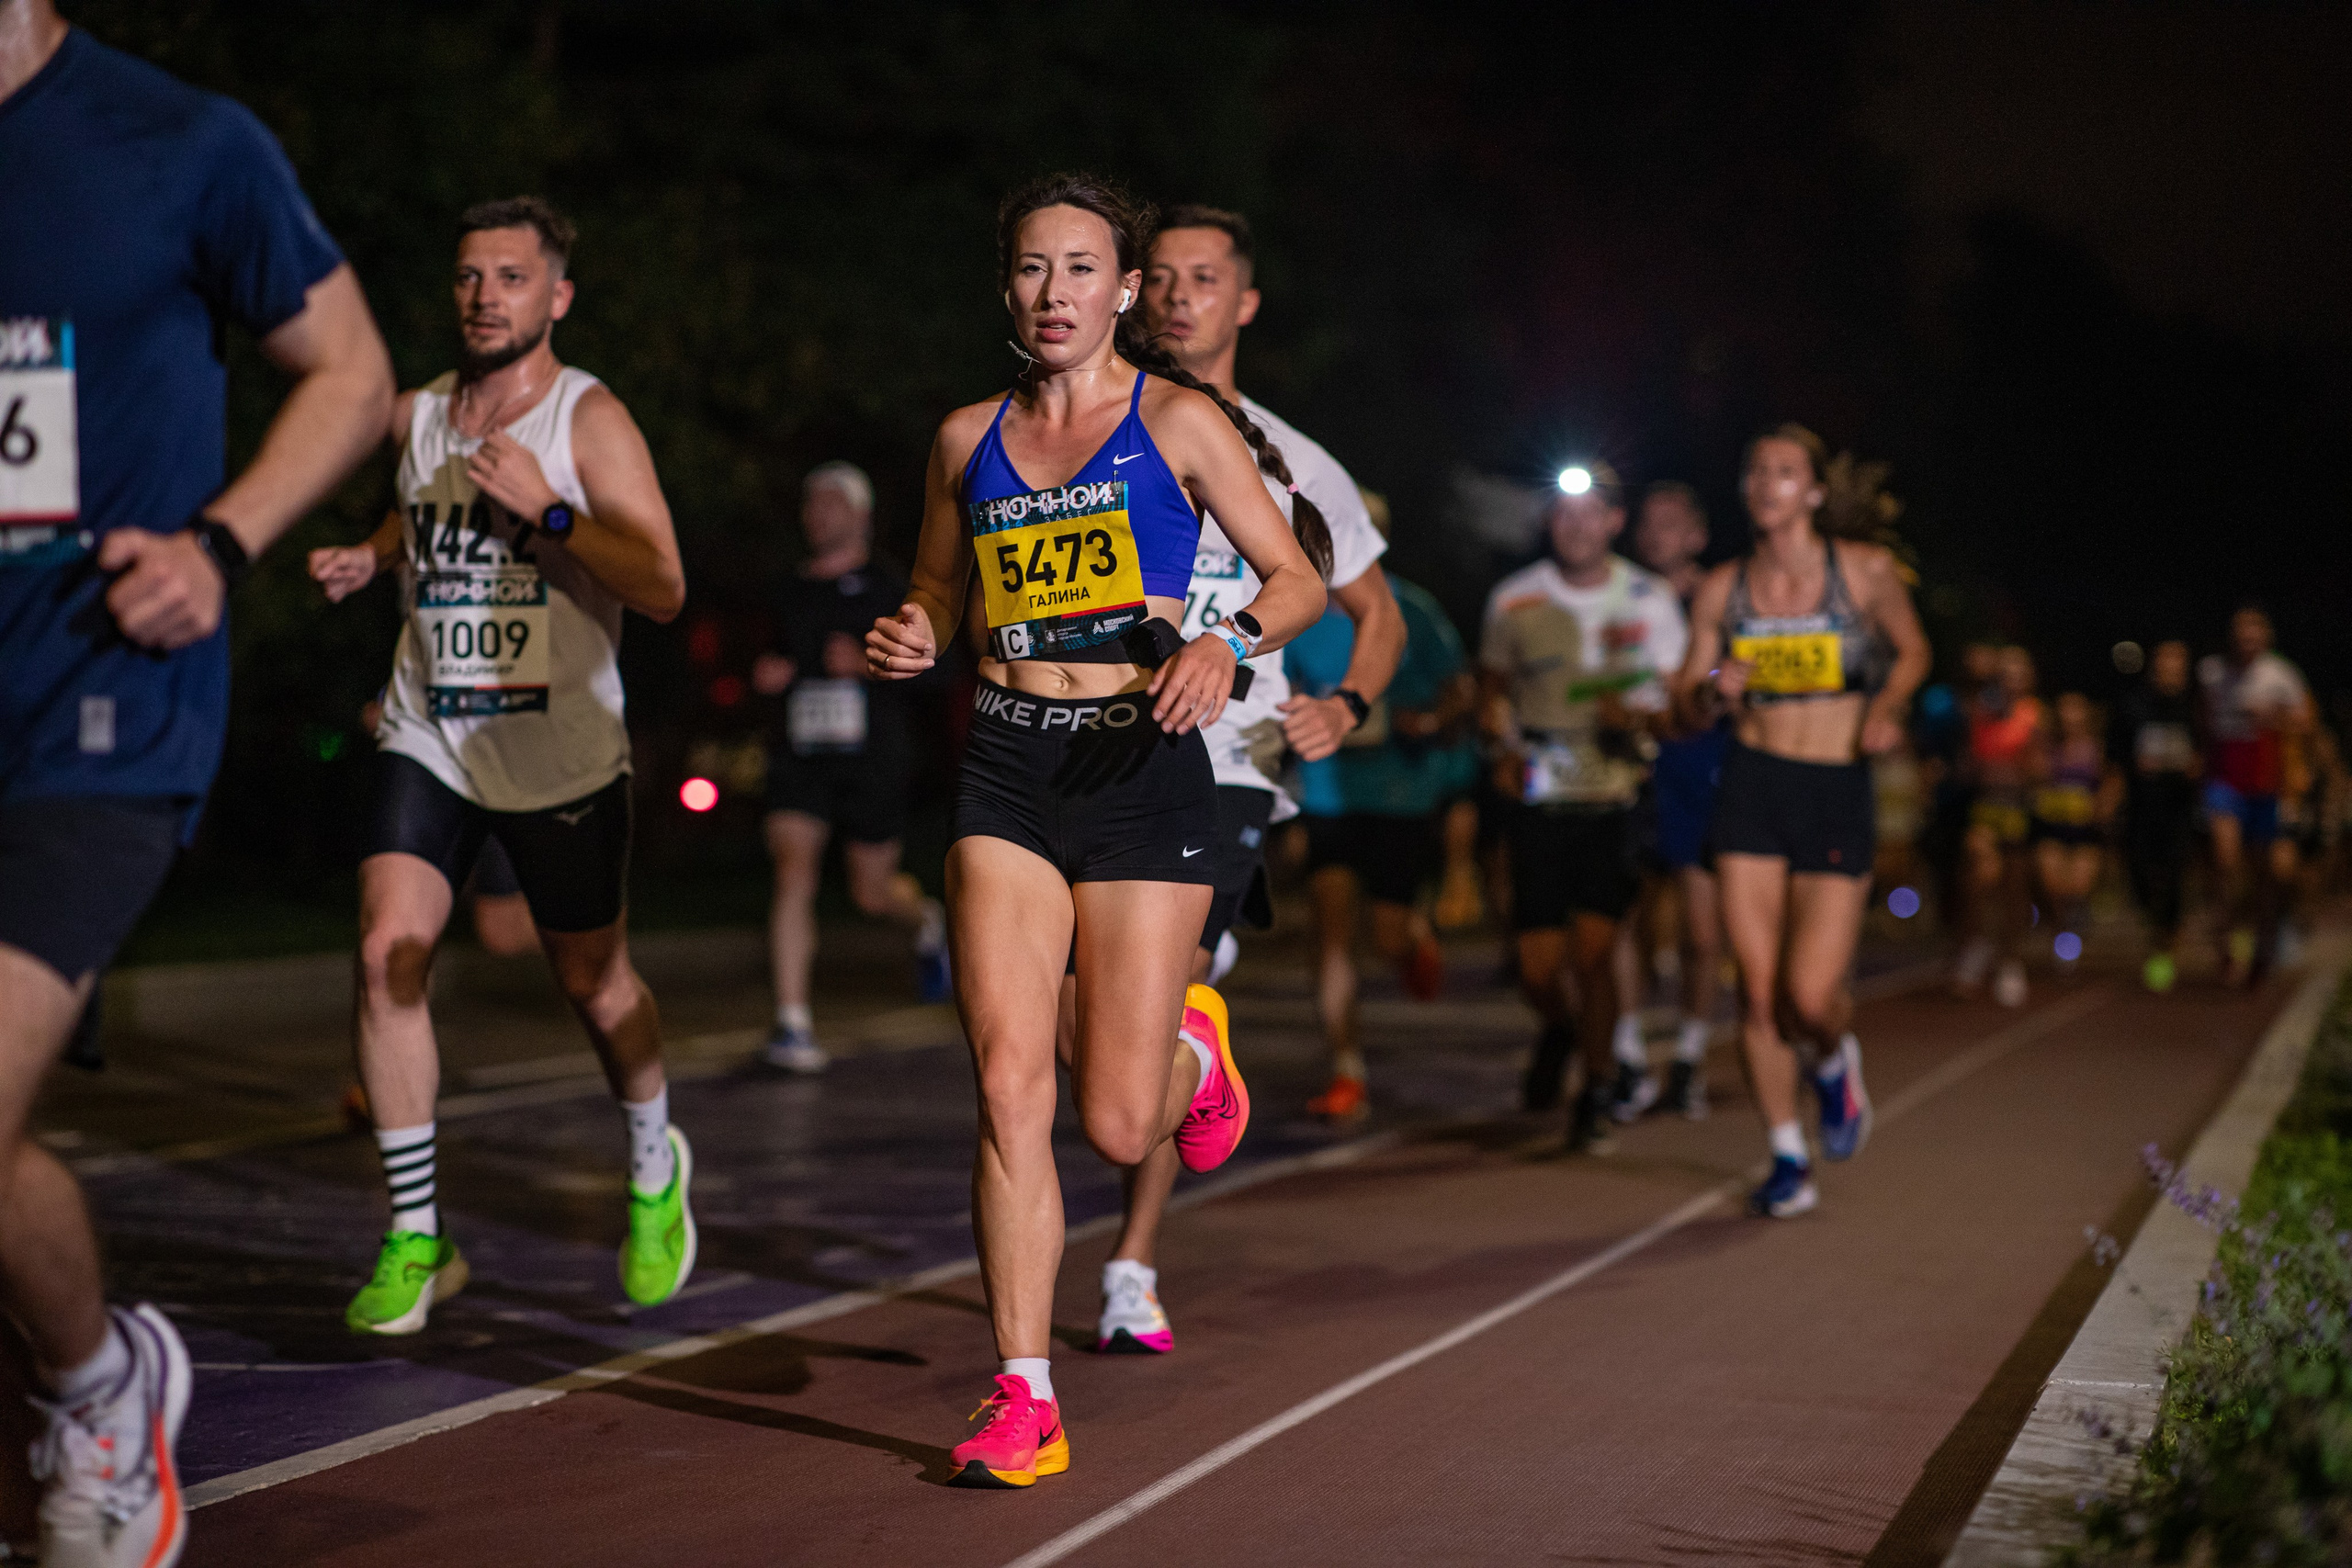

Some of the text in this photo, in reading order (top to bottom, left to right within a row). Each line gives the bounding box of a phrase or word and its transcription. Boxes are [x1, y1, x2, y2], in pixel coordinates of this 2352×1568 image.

[987, 481, 1115, 525] НОЧНОЙ
[1044, 508, 1092, 524] ЗАБЕГ
[996, 528, 1118, 593] 5473
[1028, 586, 1091, 609] ГАЛИНА
[1182, 592, 1221, 627] 76
[431, 620, 530, 660] 1009
[972, 683, 1138, 732] NIKE PRO
